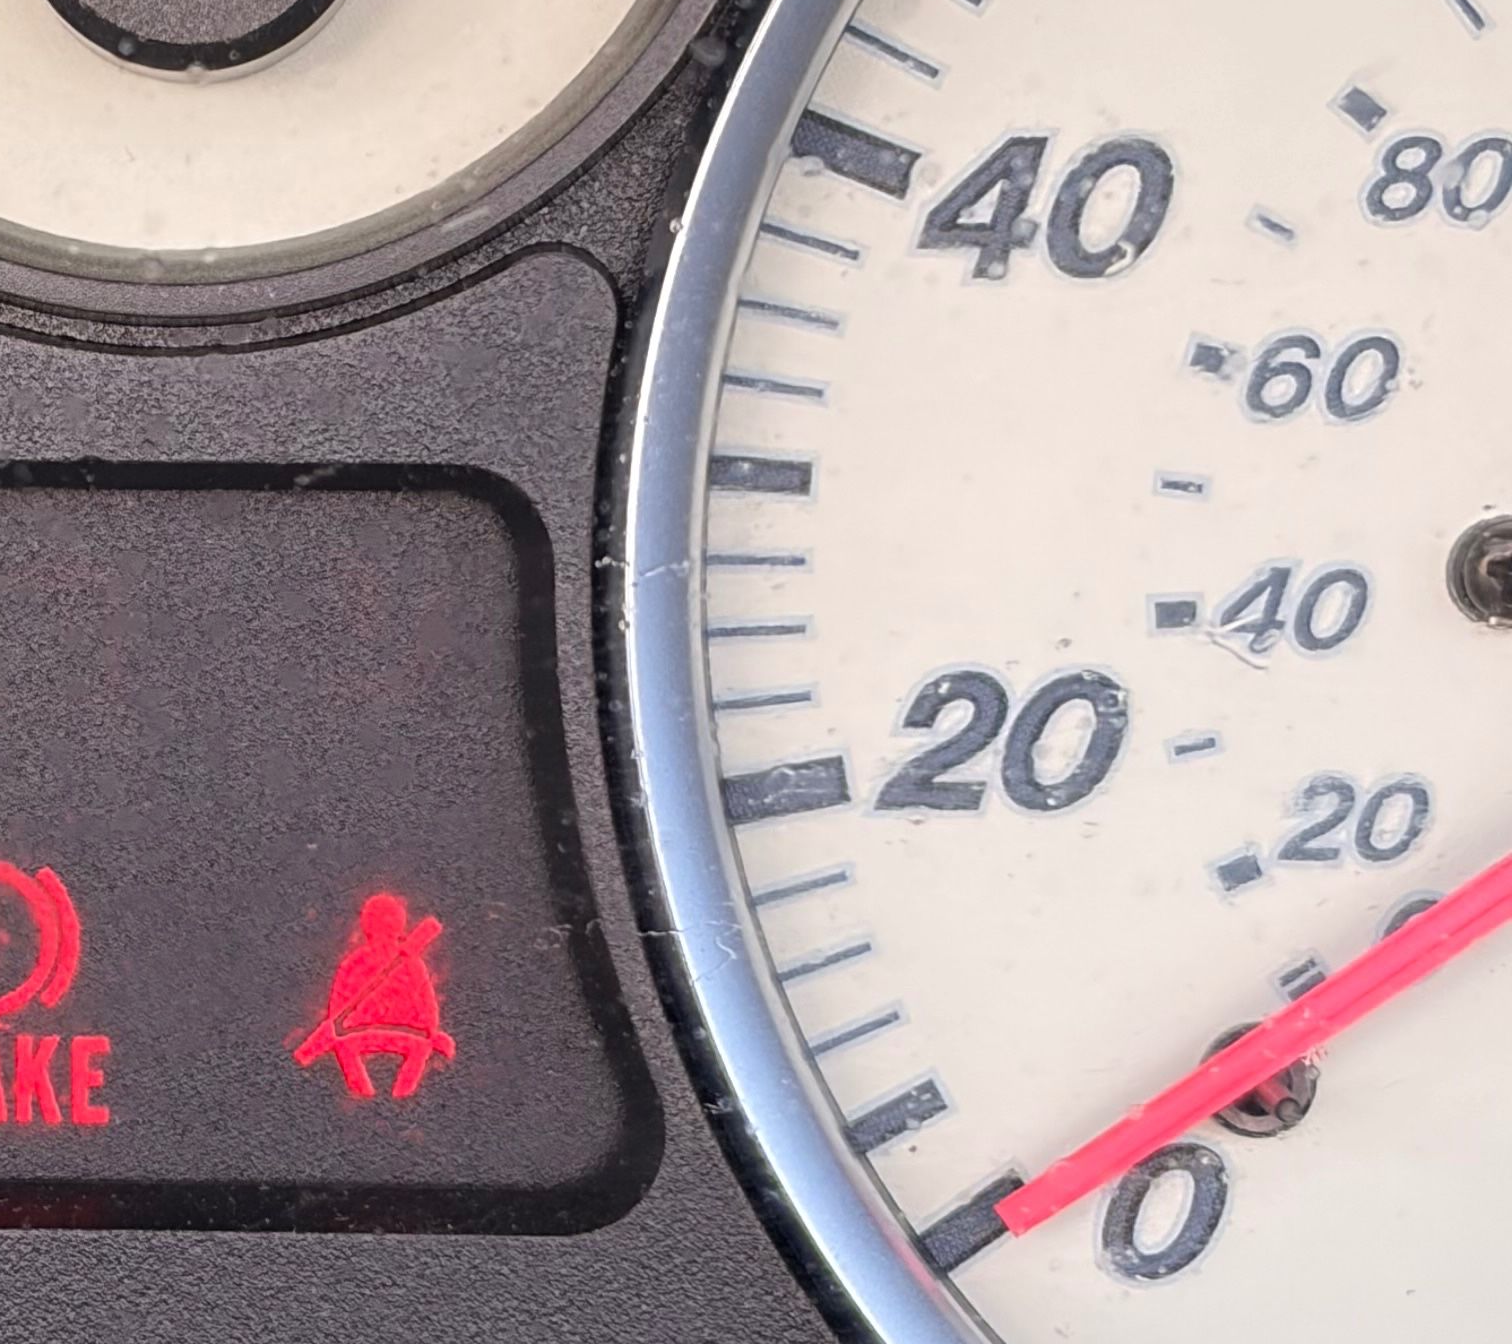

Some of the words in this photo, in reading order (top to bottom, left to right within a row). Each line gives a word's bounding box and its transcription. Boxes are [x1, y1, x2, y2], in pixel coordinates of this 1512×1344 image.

[918, 137, 1175, 279] 40
[1366, 136, 1512, 222] 80
[1245, 335, 1400, 421] 60
[1221, 567, 1369, 653] 40
[874, 670, 1130, 811] 20
[1277, 777, 1430, 861] 20
[1101, 1143, 1229, 1279] 0
